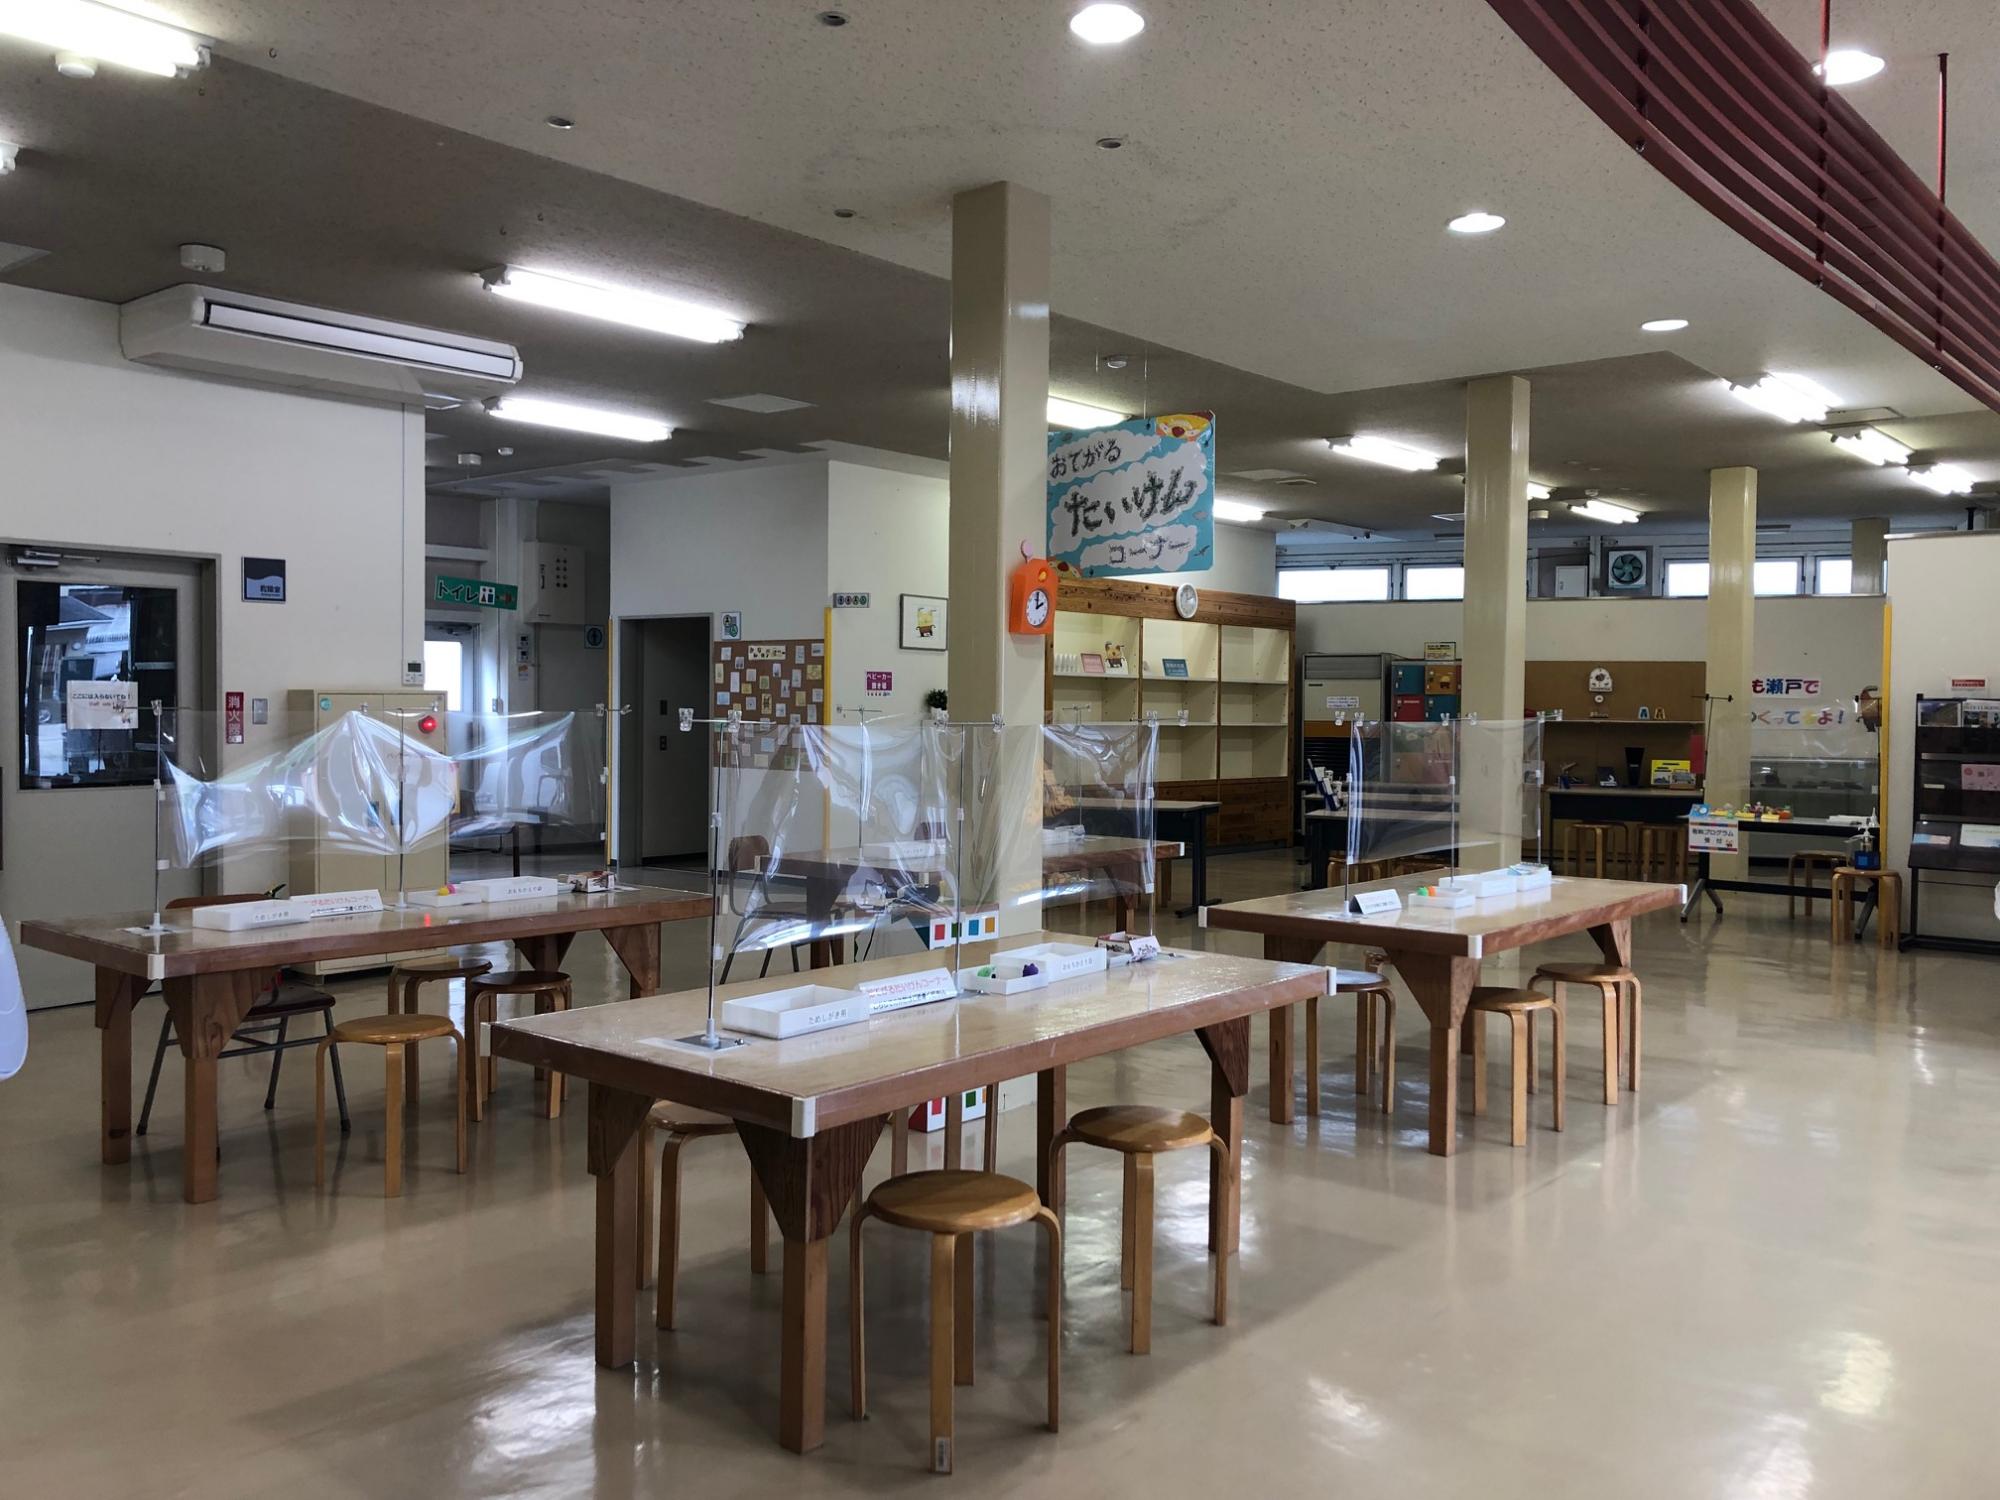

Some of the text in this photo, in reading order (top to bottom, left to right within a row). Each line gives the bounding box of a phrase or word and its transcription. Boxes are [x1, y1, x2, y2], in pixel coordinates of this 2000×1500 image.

[1050, 437, 1122, 479] おてがる
[1109, 535, 1191, 564] コーナー
[437, 580, 479, 602] トイレ
